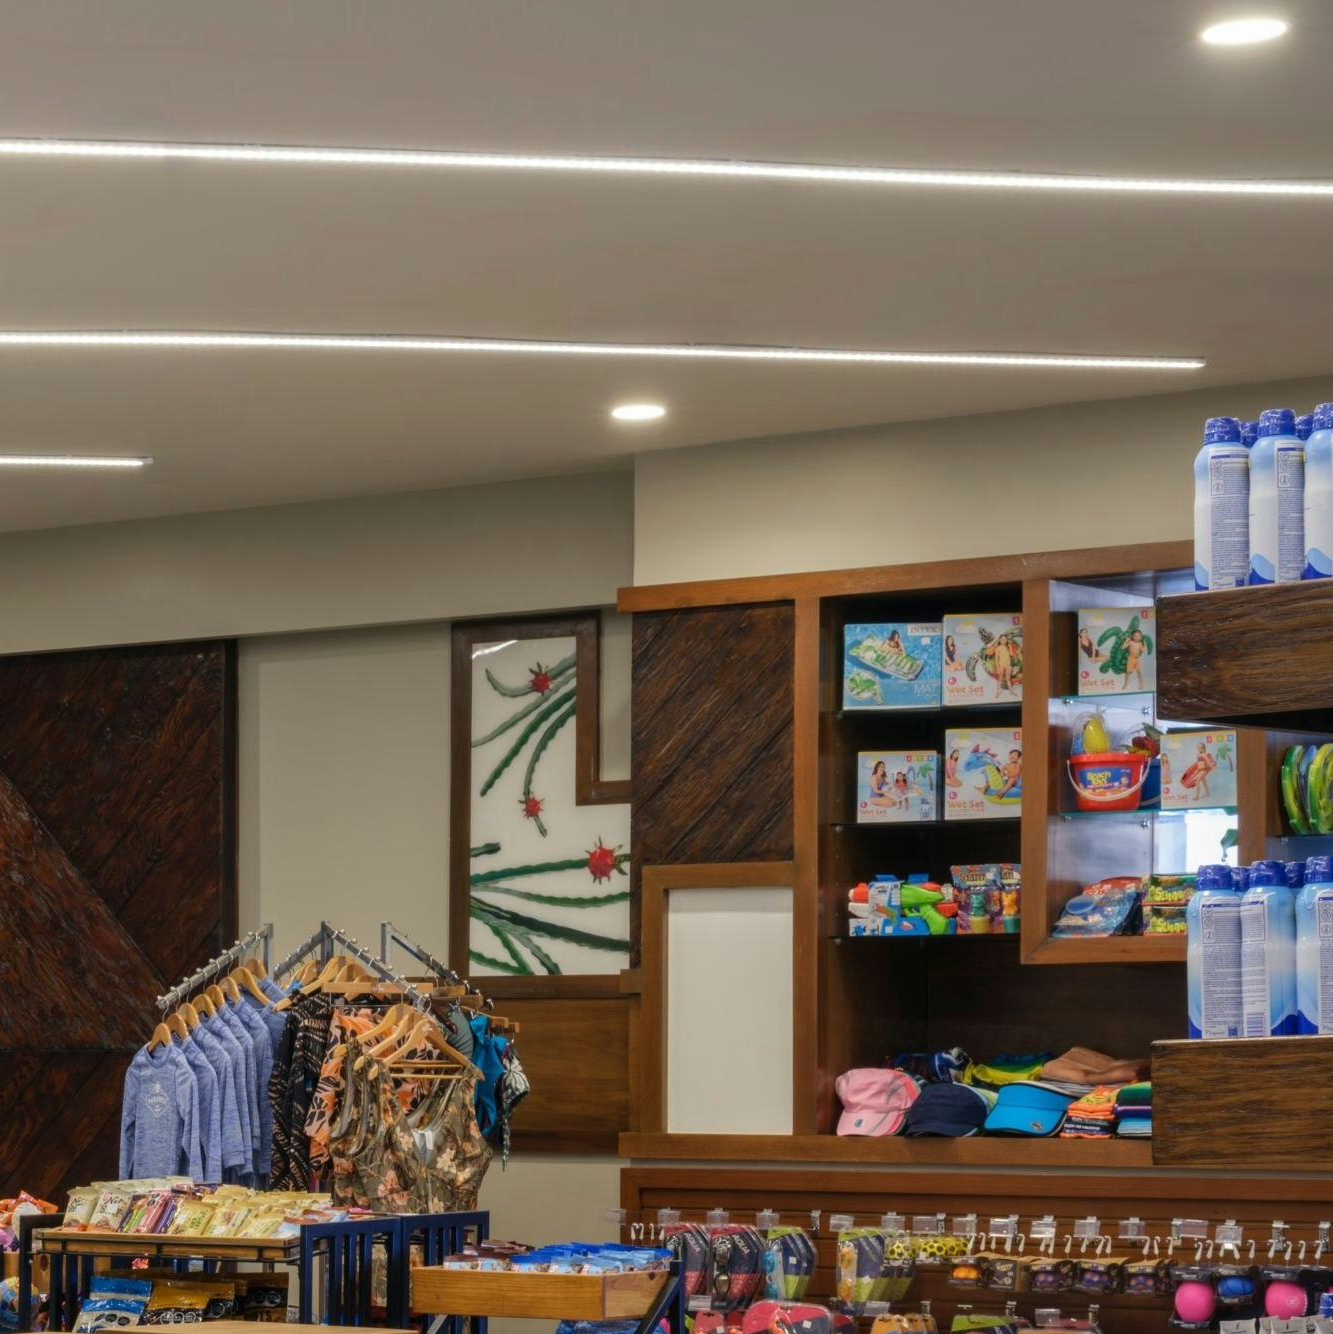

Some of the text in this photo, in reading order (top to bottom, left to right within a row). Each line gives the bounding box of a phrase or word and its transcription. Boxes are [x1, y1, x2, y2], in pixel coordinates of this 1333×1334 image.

[947, 686, 986, 694] Wet Set
[947, 800, 986, 809] Wet Set
